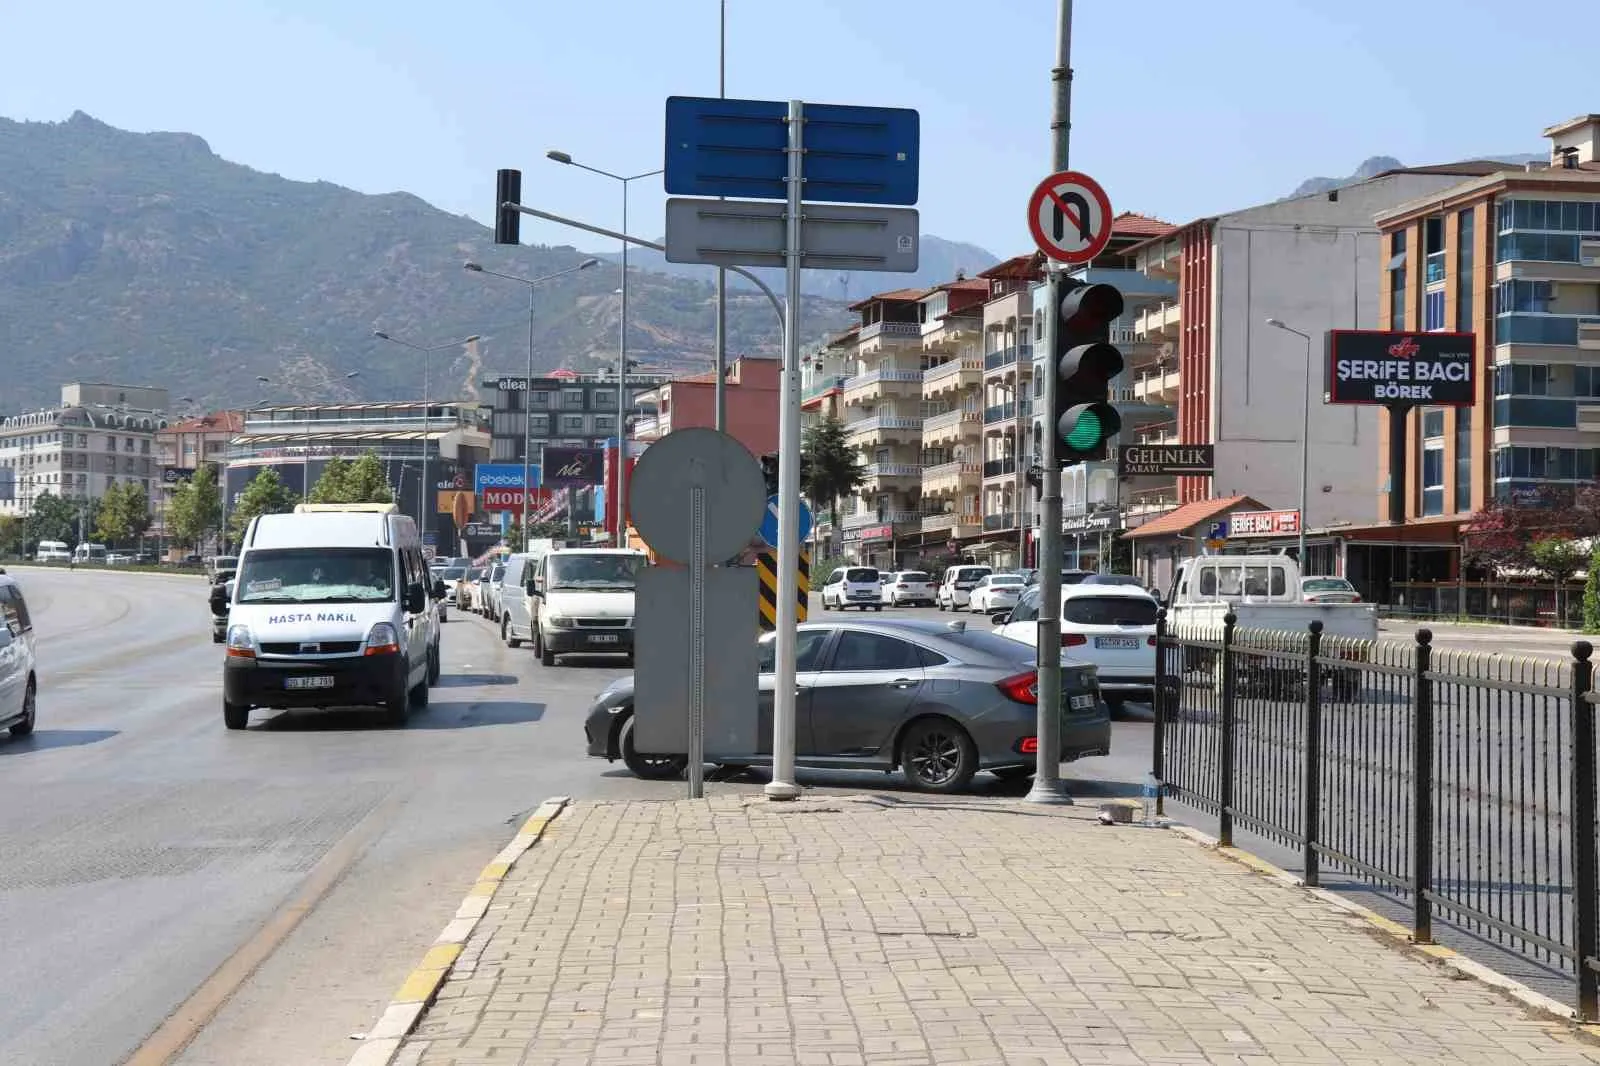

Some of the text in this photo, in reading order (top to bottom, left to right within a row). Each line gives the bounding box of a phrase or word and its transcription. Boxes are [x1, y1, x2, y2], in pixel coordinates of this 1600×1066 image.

[1415, 361, 1470, 382] BACI
[1374, 381, 1433, 399] BÖREK
[268, 613, 312, 625] HASTA
